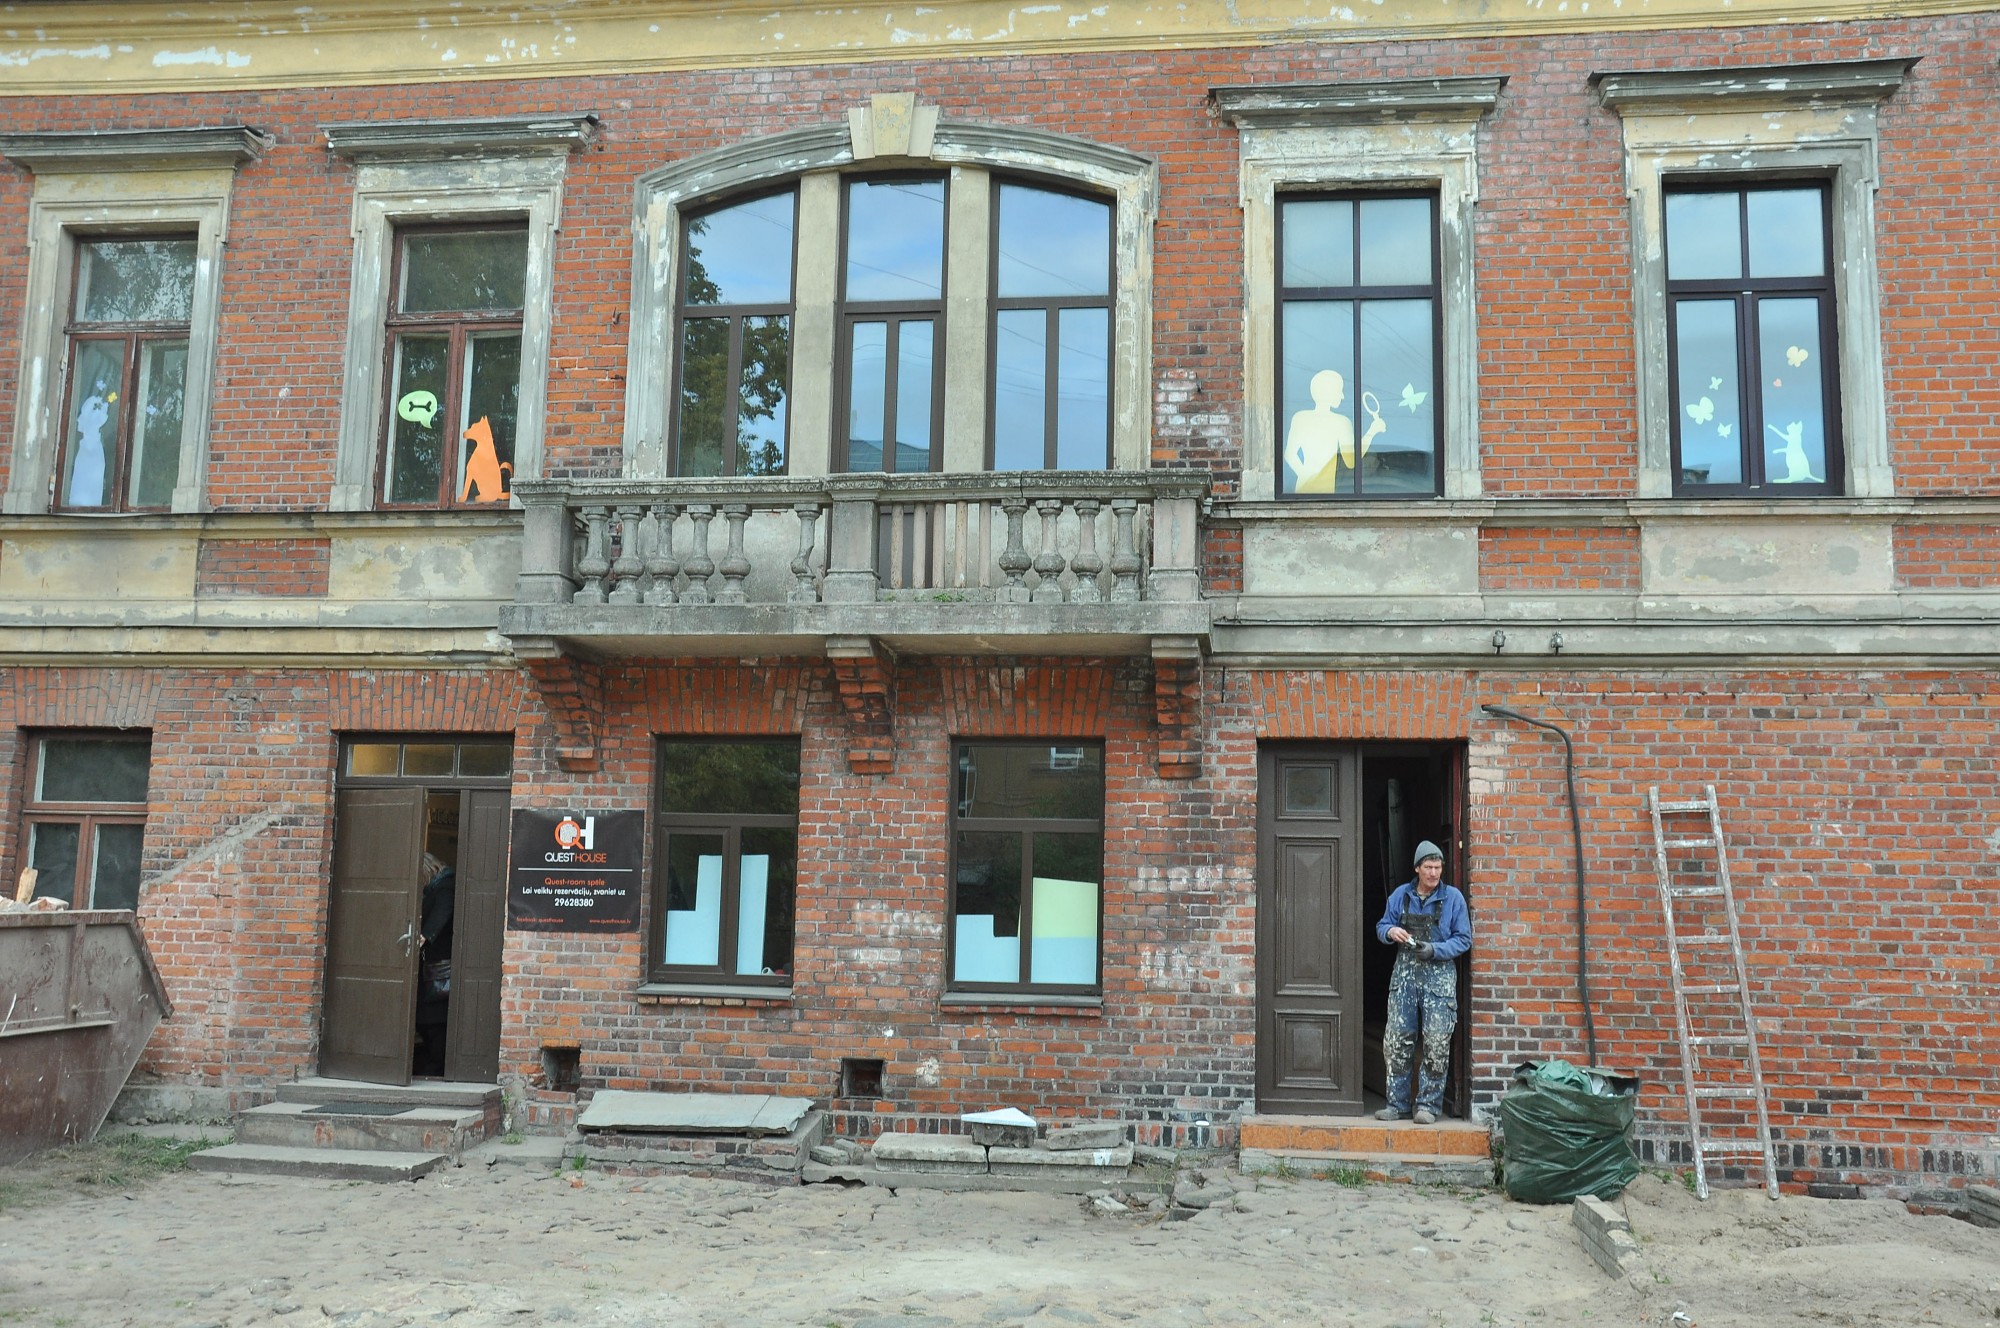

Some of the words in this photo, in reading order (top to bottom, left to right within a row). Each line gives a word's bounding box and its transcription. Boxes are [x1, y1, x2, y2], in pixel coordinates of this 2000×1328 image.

[544, 877, 586, 886] Quest-room
[522, 886, 533, 895] Lai
[533, 886, 553, 895] veiktu
[593, 888, 617, 896] zvaniet
[554, 898, 594, 907] 29628380
